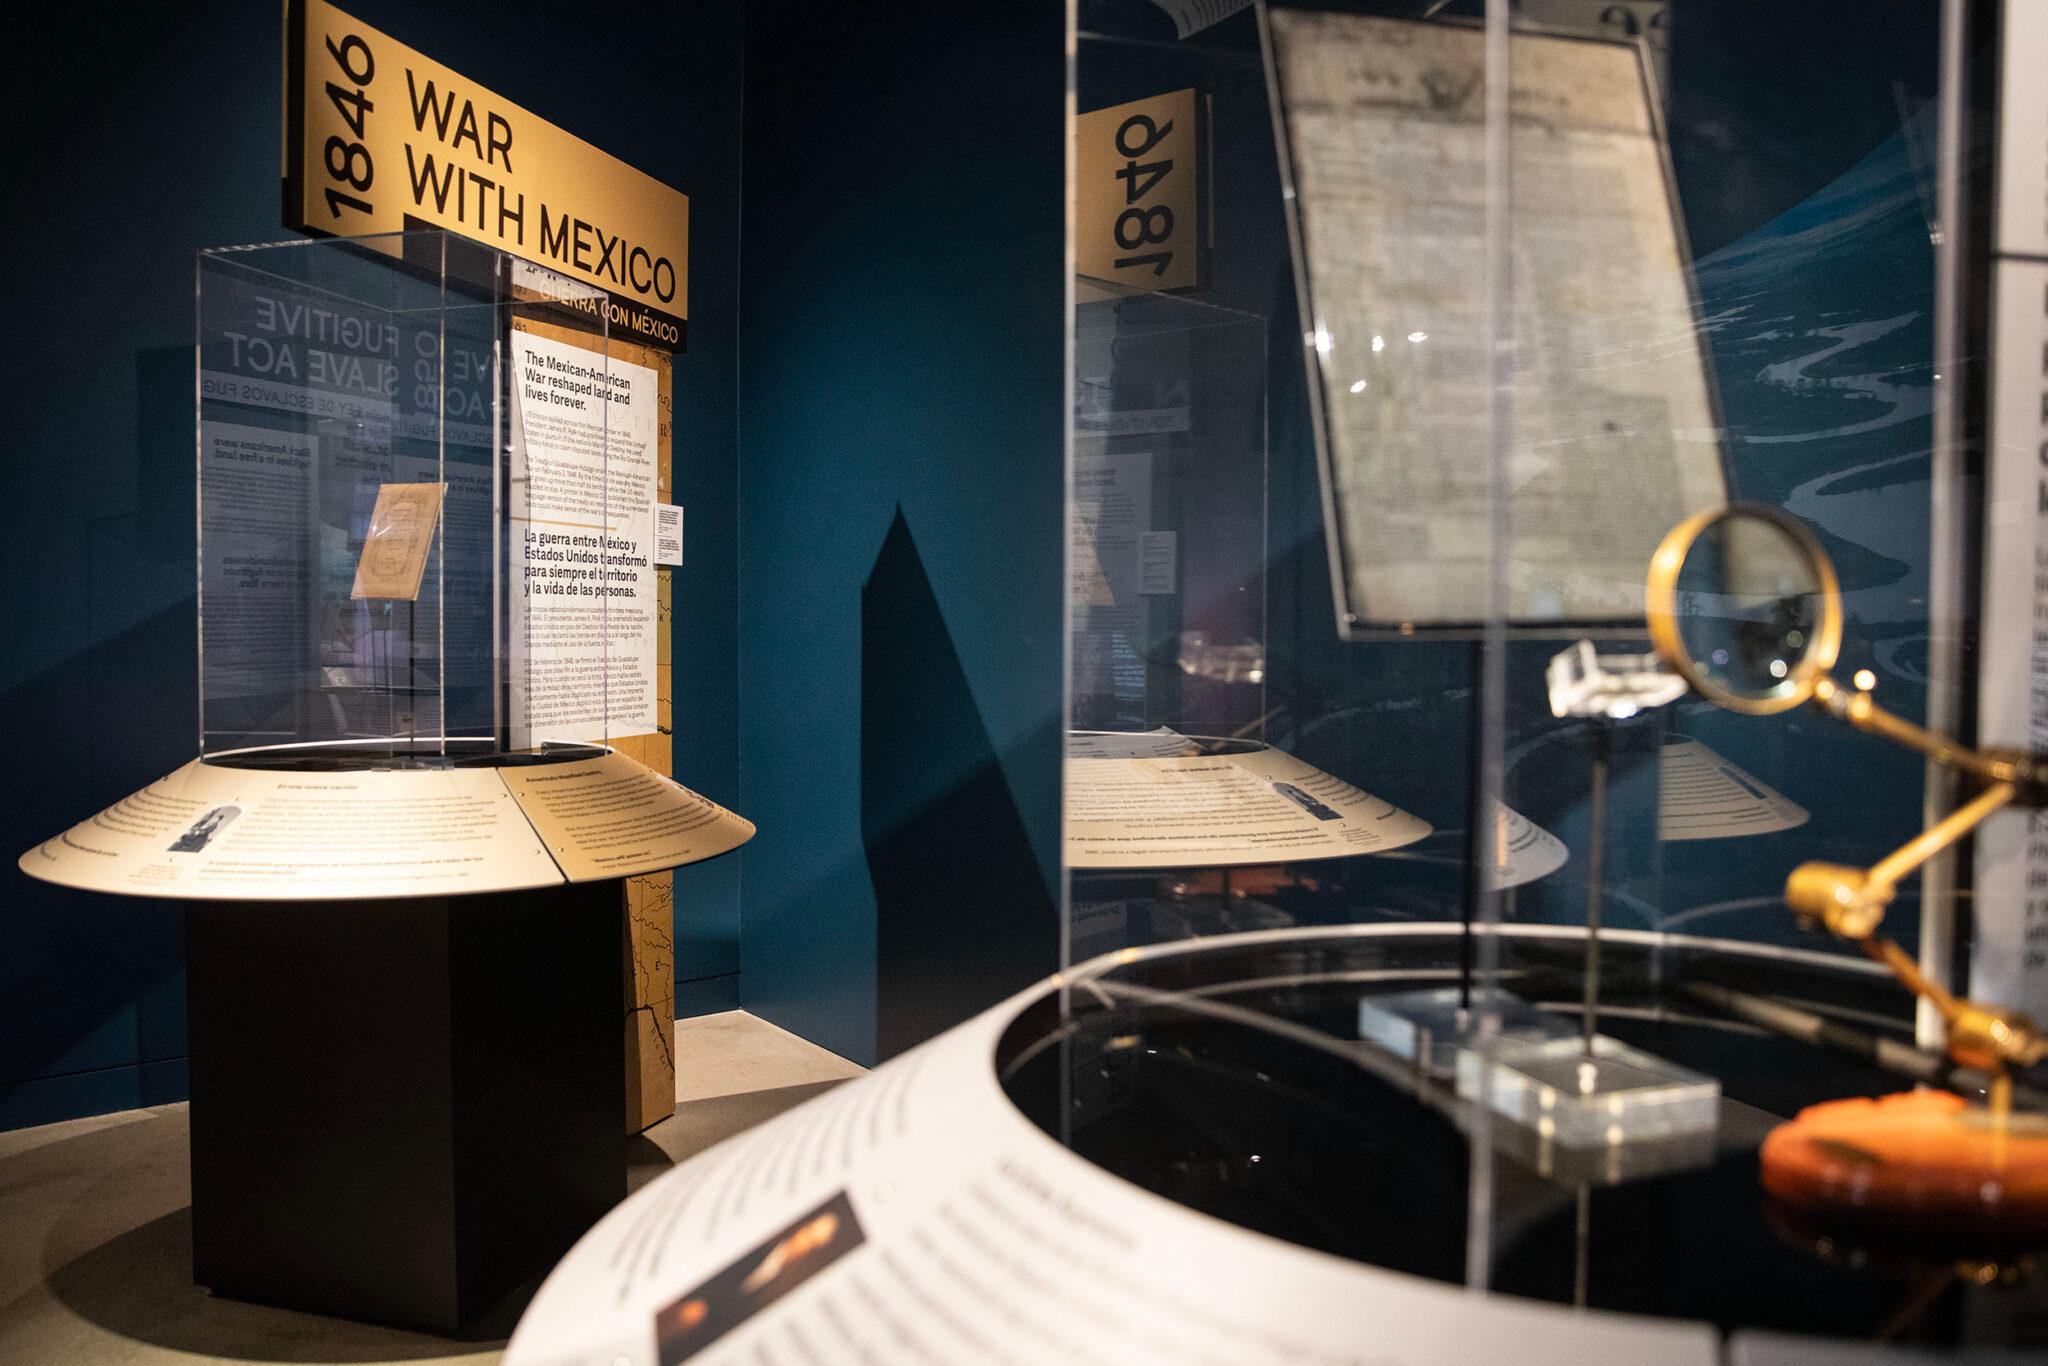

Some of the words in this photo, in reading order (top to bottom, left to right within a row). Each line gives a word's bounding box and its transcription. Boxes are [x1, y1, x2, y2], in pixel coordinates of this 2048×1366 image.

[324, 34, 375, 219] 1846
[405, 68, 514, 174] WAR
[405, 143, 525, 246] WITH
[540, 204, 676, 304] MEXICO
[540, 280, 597, 316] GUERRA
[601, 300, 629, 327] CON
[632, 308, 679, 344] MÉXICO
[524, 349, 543, 367] The
[524, 366, 545, 384] War
[548, 372, 591, 398] reshaped
[614, 389, 629, 405] and
[525, 383, 547, 402] lives
[550, 389, 586, 411] forever.
[524, 527, 536, 542] La
[538, 531, 570, 549] guerra
[572, 533, 597, 548] entre
[599, 534, 629, 550] México
[631, 541, 636, 554] y
[524, 545, 563, 561] Estados
[566, 548, 598, 564] Unidos
[600, 550, 647, 568] tansformó
[524, 565, 546, 581] para
[549, 564, 586, 582] siempre
[588, 567, 597, 579] el
[598, 566, 637, 582] trritorio
[524, 582, 530, 597] y
[532, 580, 541, 594] la
[544, 580, 564, 595] vida
[566, 581, 577, 595] de
[580, 582, 593, 596] las
